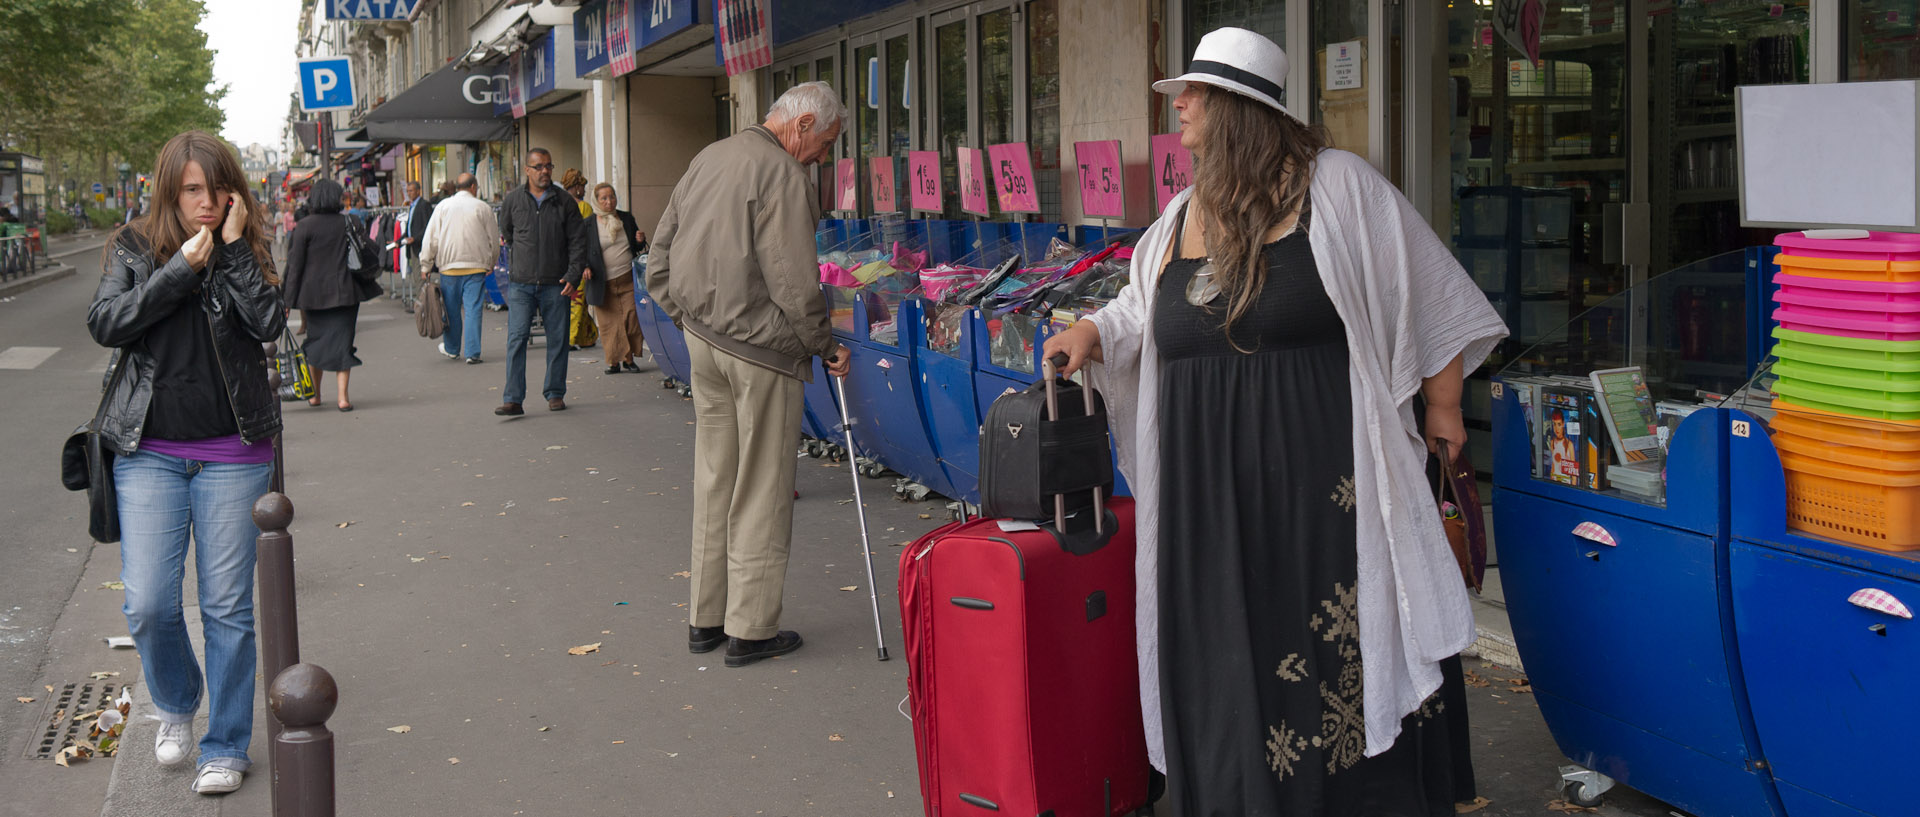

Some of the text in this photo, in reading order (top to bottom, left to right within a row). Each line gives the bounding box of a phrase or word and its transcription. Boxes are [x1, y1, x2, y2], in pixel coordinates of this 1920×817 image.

[333, 0, 410, 18] KATA
[585, 8, 602, 60] 2M
[313, 68, 338, 101] P
[1734, 423, 1747, 435] 12
